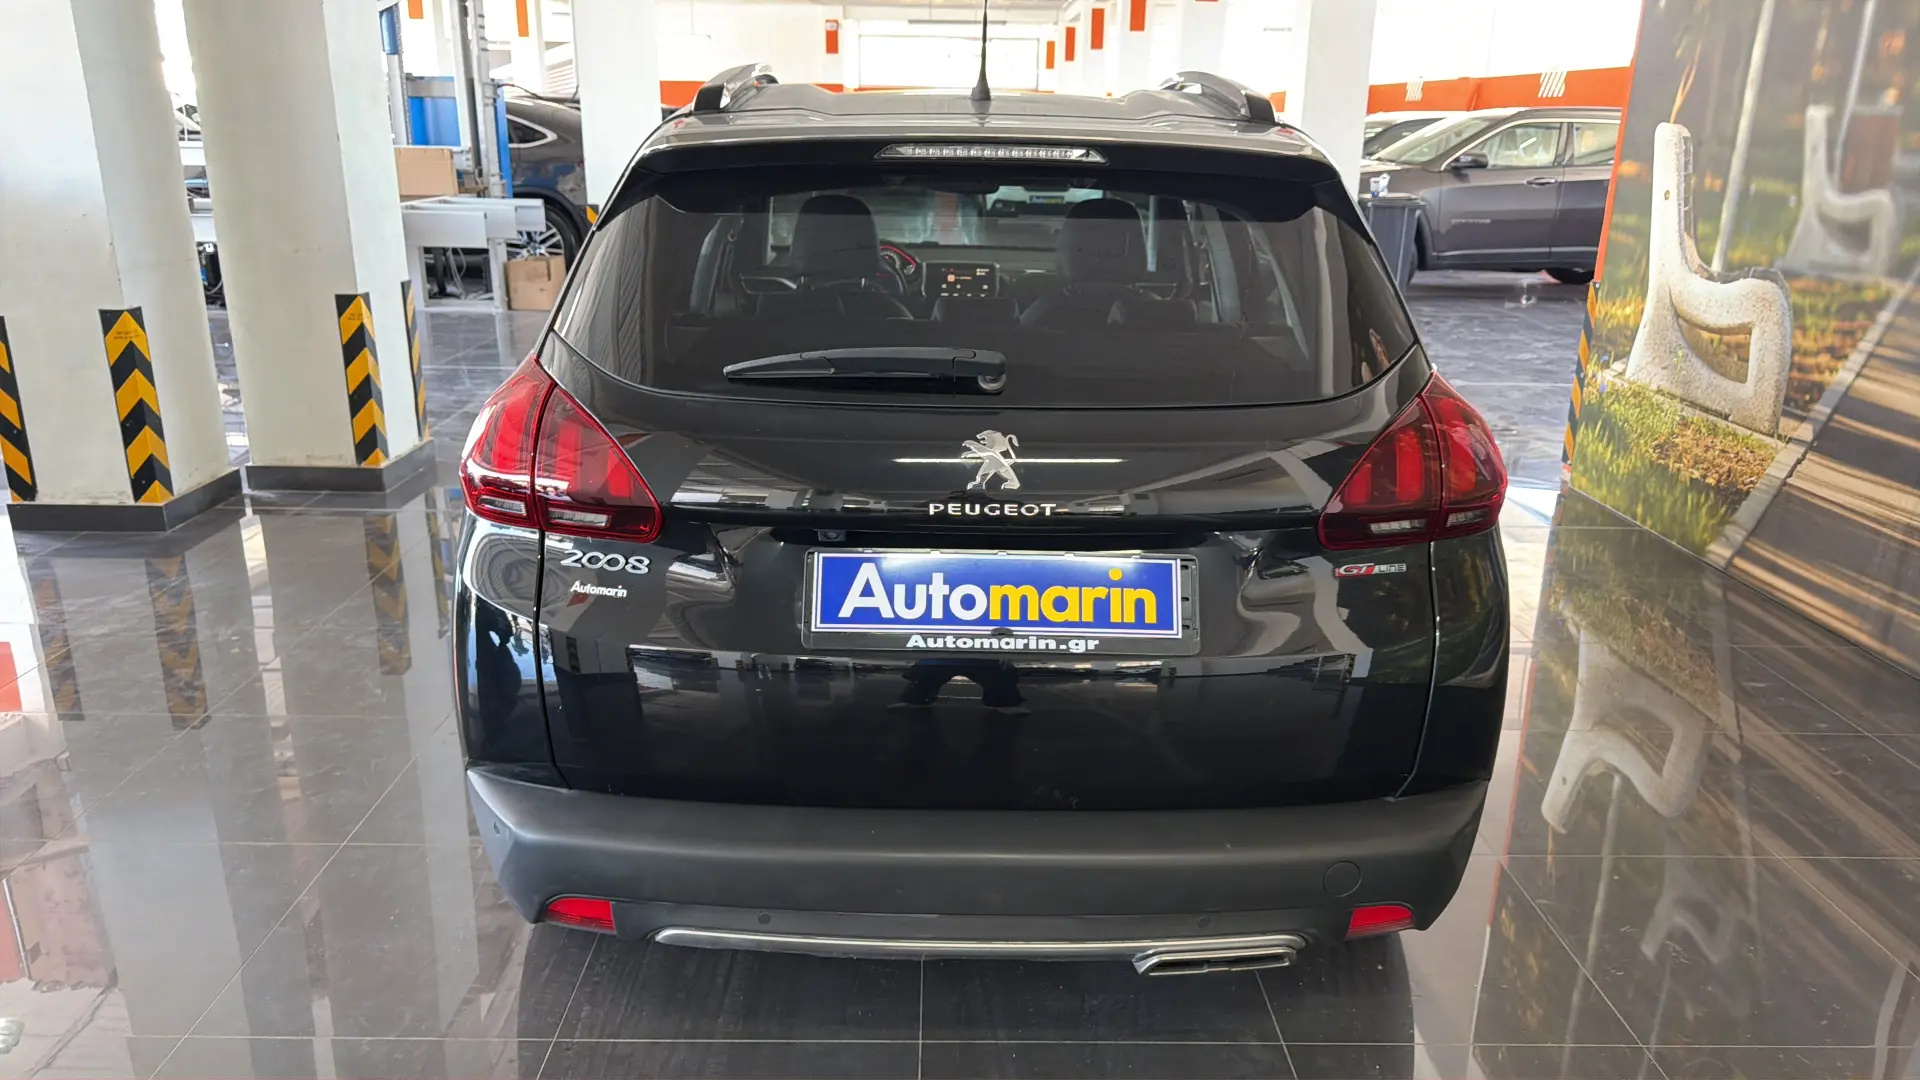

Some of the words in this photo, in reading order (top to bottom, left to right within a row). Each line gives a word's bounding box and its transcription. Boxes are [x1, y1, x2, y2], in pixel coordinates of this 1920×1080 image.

[928, 502, 1057, 517] PEUGEOT
[560, 549, 651, 575] 2008
[1338, 563, 1375, 575] GT
[570, 580, 627, 598] Automarin
[838, 562, 1157, 624] Automarin
[906, 633, 1099, 653] Automarin.gr
